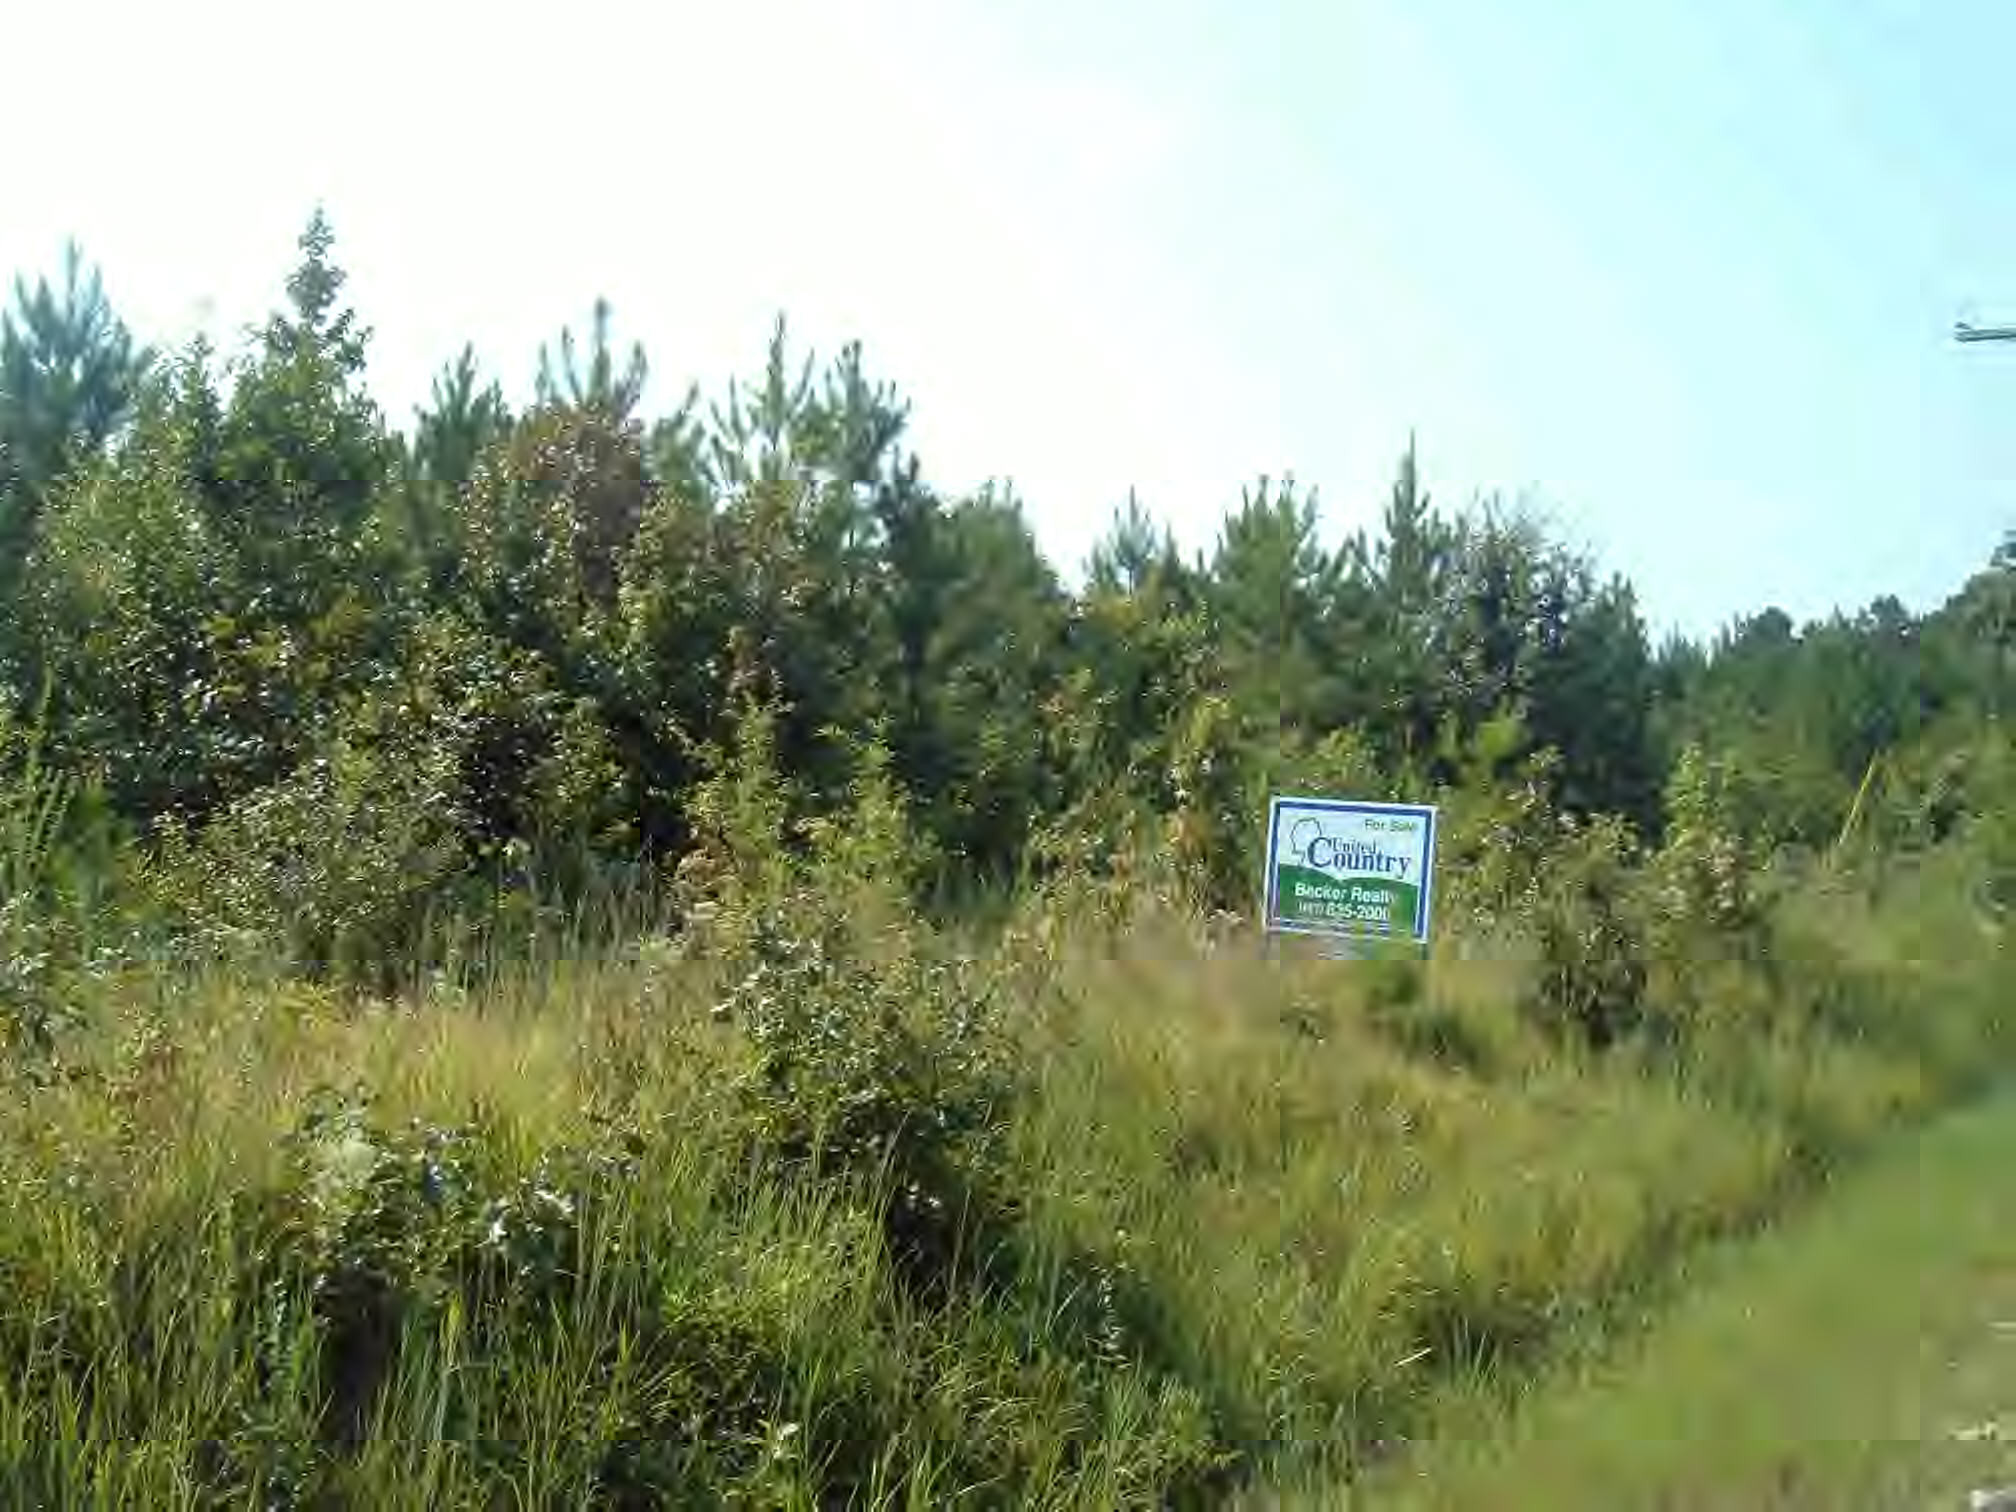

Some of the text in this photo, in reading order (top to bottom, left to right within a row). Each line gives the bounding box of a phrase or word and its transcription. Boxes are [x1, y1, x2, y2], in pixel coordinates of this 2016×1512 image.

[1365, 819, 1385, 831] For
[1331, 837, 1376, 854] United
[1307, 837, 1411, 879] Country
